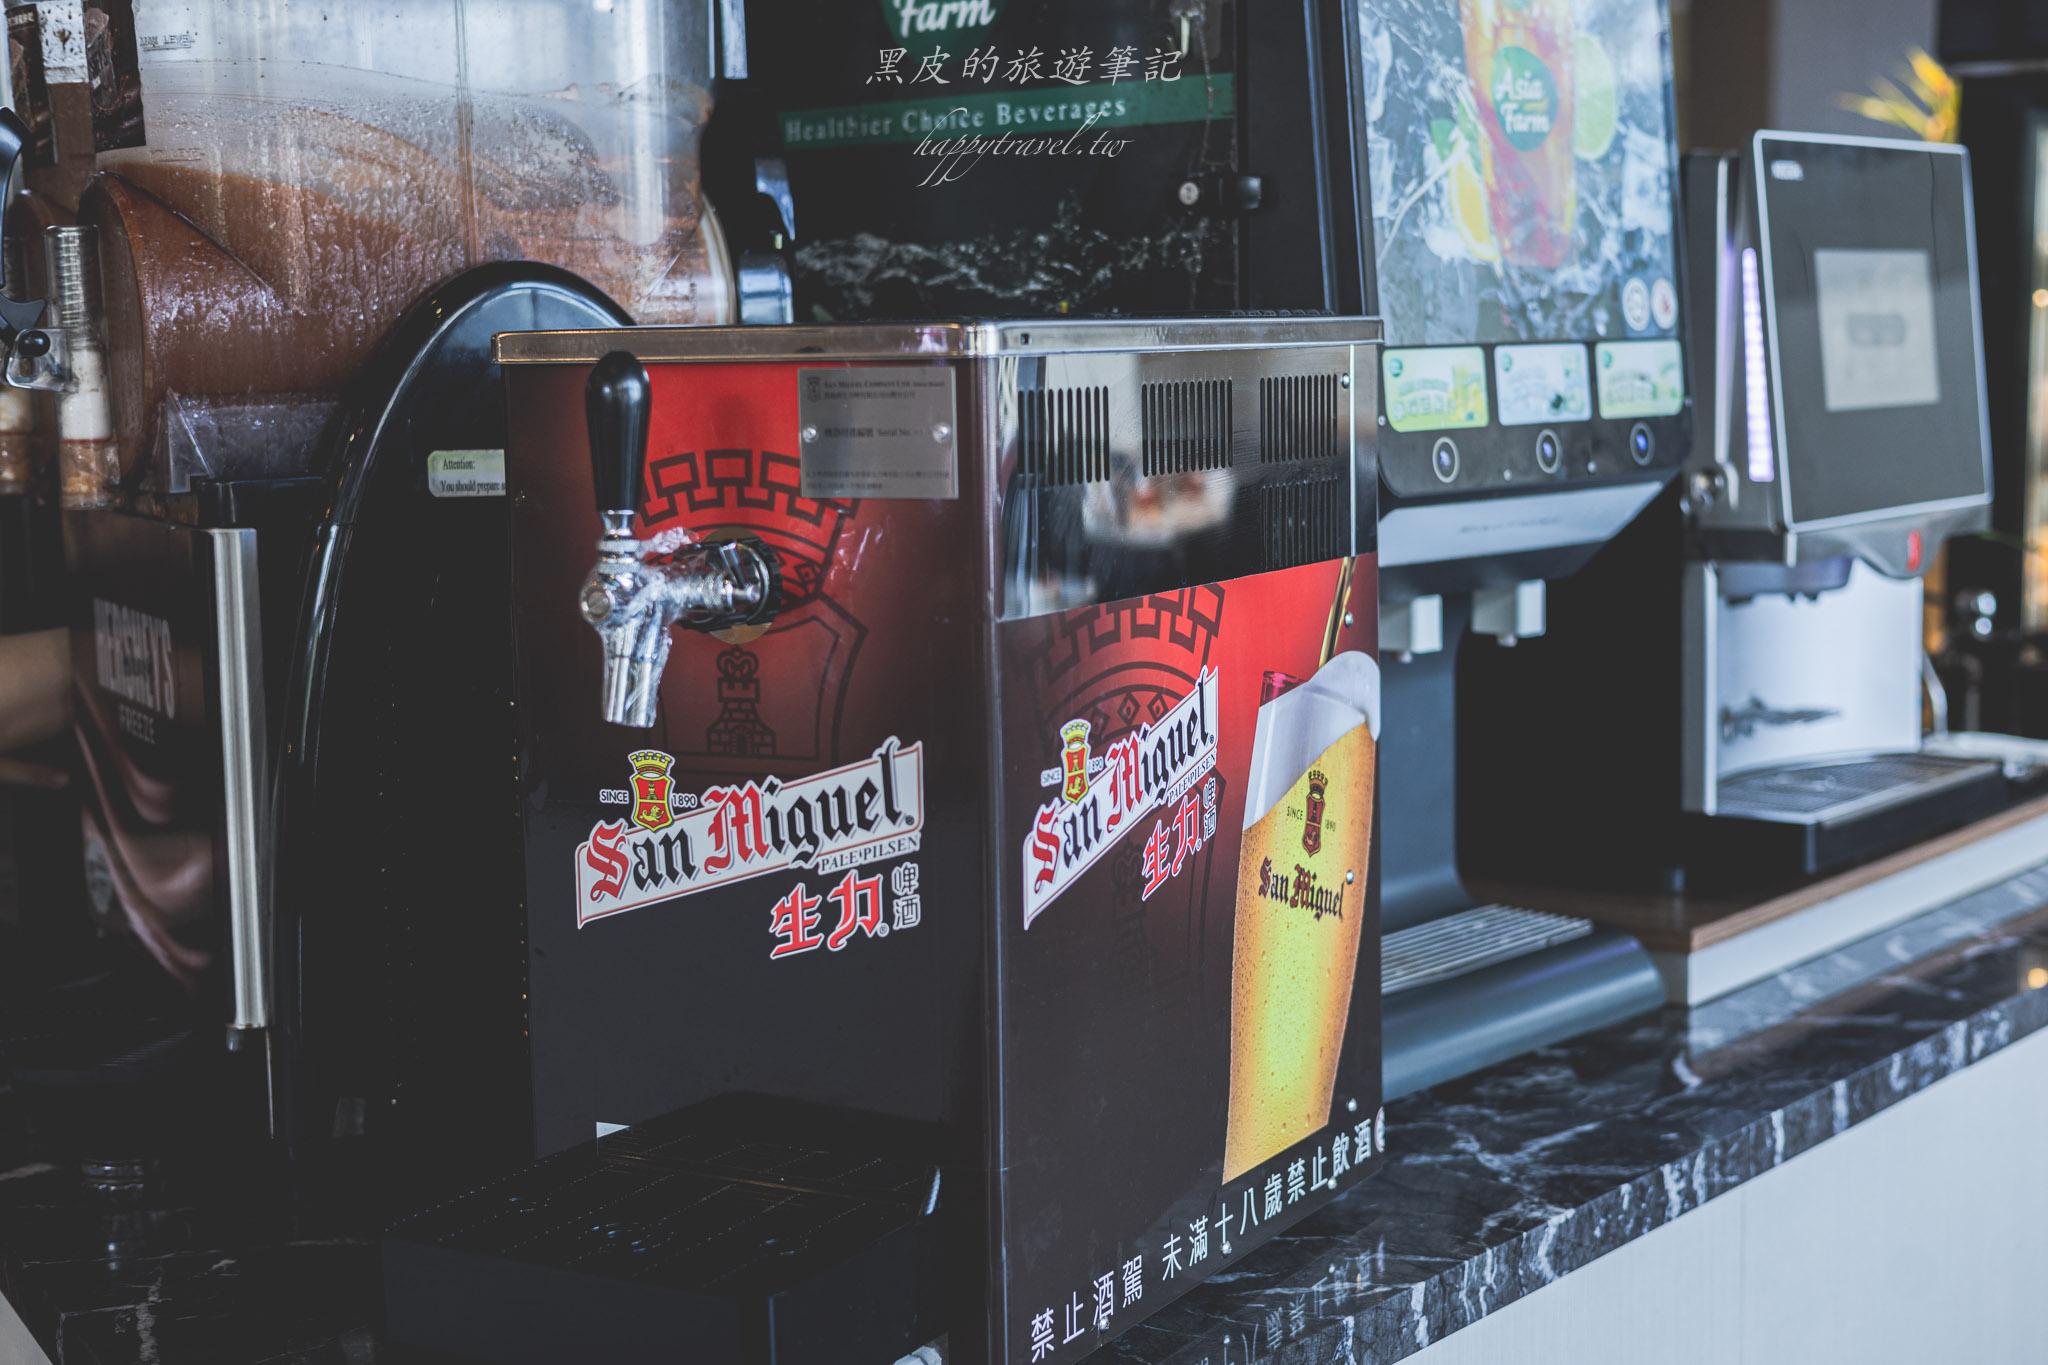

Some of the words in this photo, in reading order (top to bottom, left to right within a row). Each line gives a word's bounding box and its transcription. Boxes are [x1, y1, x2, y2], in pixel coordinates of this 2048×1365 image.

[1496, 66, 1543, 100] Asia
[785, 113, 892, 142] Healthier
[901, 107, 985, 134] Choice
[996, 98, 1127, 126] Beverages
[1501, 102, 1550, 135] Farm
[443, 456, 476, 471] Attention:
[440, 480, 454, 492] You
[455, 480, 476, 492] should
[1033, 803, 1103, 895] San
[1106, 668, 1212, 835] Miguel
[1042, 768, 1062, 786] SINCE
[1088, 757, 1104, 773] 1890
[1169, 777, 1190, 804] PALE
[1189, 752, 1216, 786] PILSEN
[600, 789, 629, 805] SINCE
[672, 793, 697, 807] 1890
[1286, 805, 1304, 821] SINCE
[586, 821, 698, 904] San
[703, 744, 904, 875] Miguel
[820, 852, 858, 873] PALE
[862, 834, 920, 864] PILSEN
[1142, 794, 1200, 901] 生力
[891, 861, 922, 931] 啤酒
[1258, 855, 1289, 905] San
[1289, 863, 1344, 922] Miguel
[769, 868, 887, 960] 生力
[1030, 1253, 1143, 1365] 禁止酒駕
[1161, 1117, 1373, 1282] 未滿十八歲禁止飲酒
